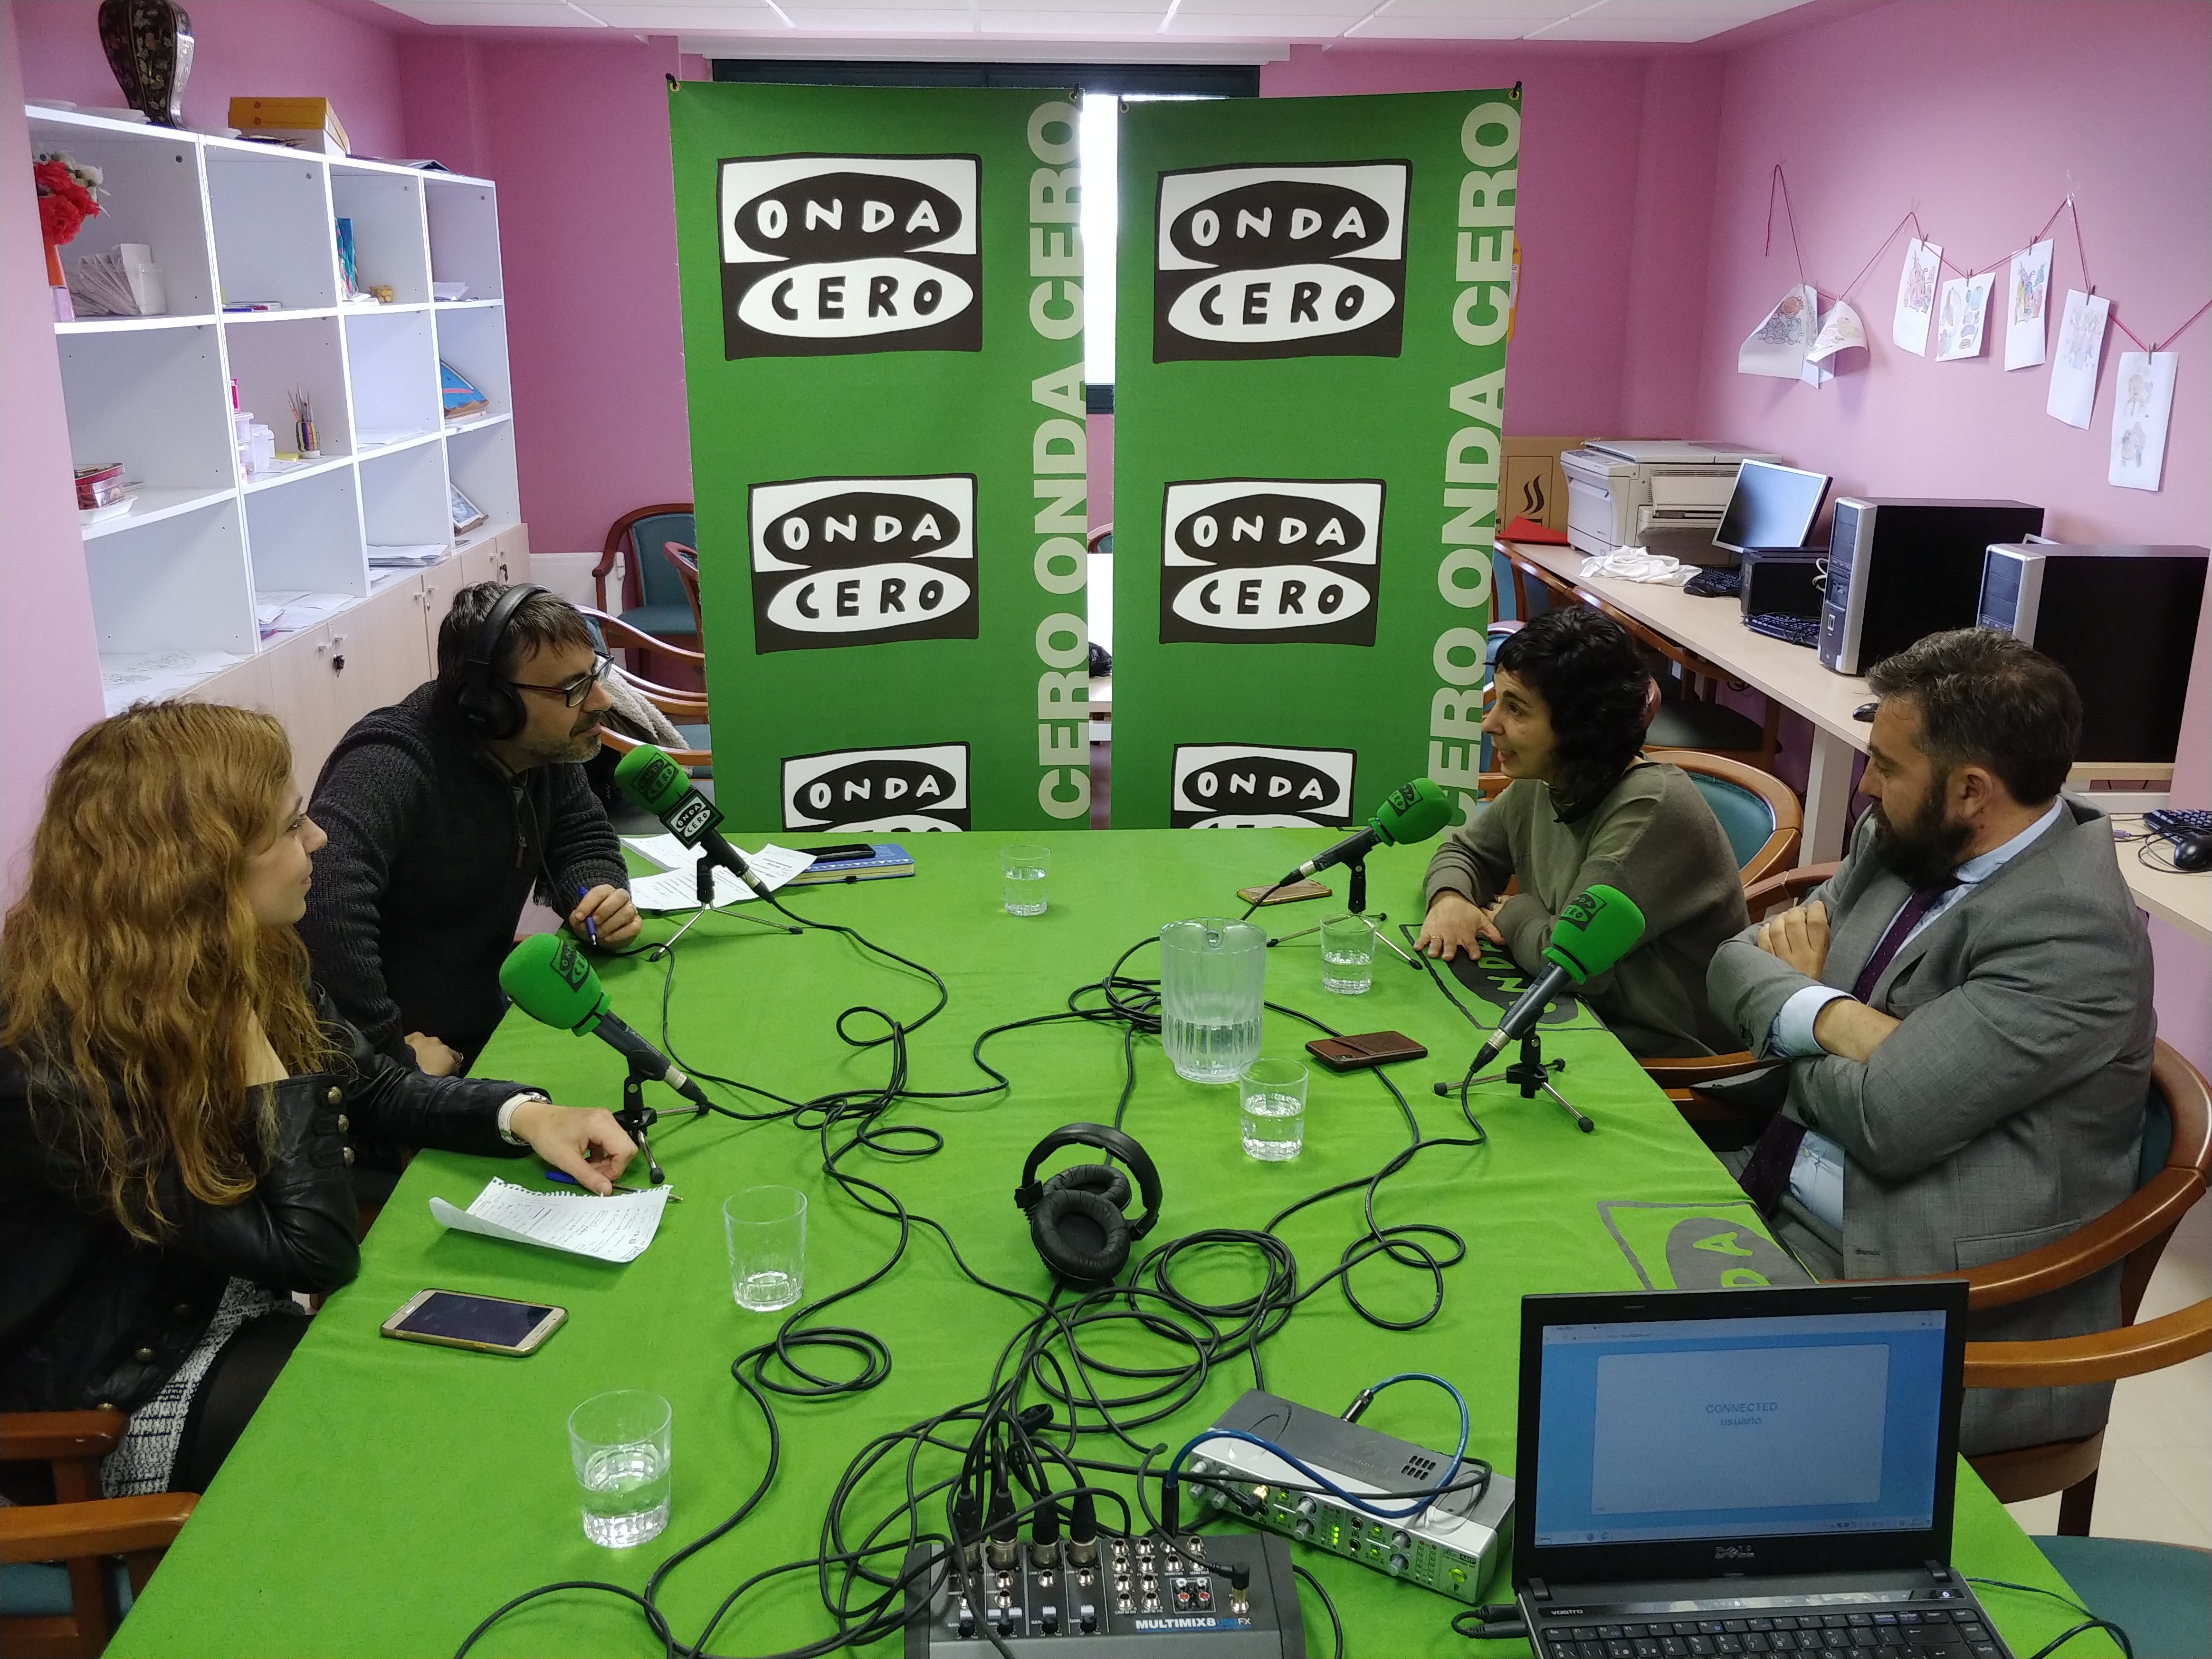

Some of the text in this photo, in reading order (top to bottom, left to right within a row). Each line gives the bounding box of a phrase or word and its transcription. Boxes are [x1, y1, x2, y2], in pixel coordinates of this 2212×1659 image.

[757, 199, 940, 238] ONDA
[1192, 206, 1366, 247] ONDA
[1452, 102, 1521, 346] CERO
[772, 276, 943, 321] CERO
[1200, 281, 1364, 326] CERO
[1027, 101, 1090, 820] CERO ONDA CERO
[1438, 368, 1505, 608] ONDA
[783, 514, 942, 550] ONDA
[1193, 515, 1345, 548] ONDA
[796, 578, 944, 619] CERO
[1200, 579, 1344, 615] CERO
[809, 774, 941, 809] ONDA
[1197, 771, 1324, 801] ONDA
[677, 805, 701, 826] ONDA
[687, 812, 708, 833] CERO
[1706, 1402, 1778, 1413] CONNECTED
[1715, 1545, 1755, 1559] DELL
[1135, 1617, 1216, 1630] MULTIMIX8
